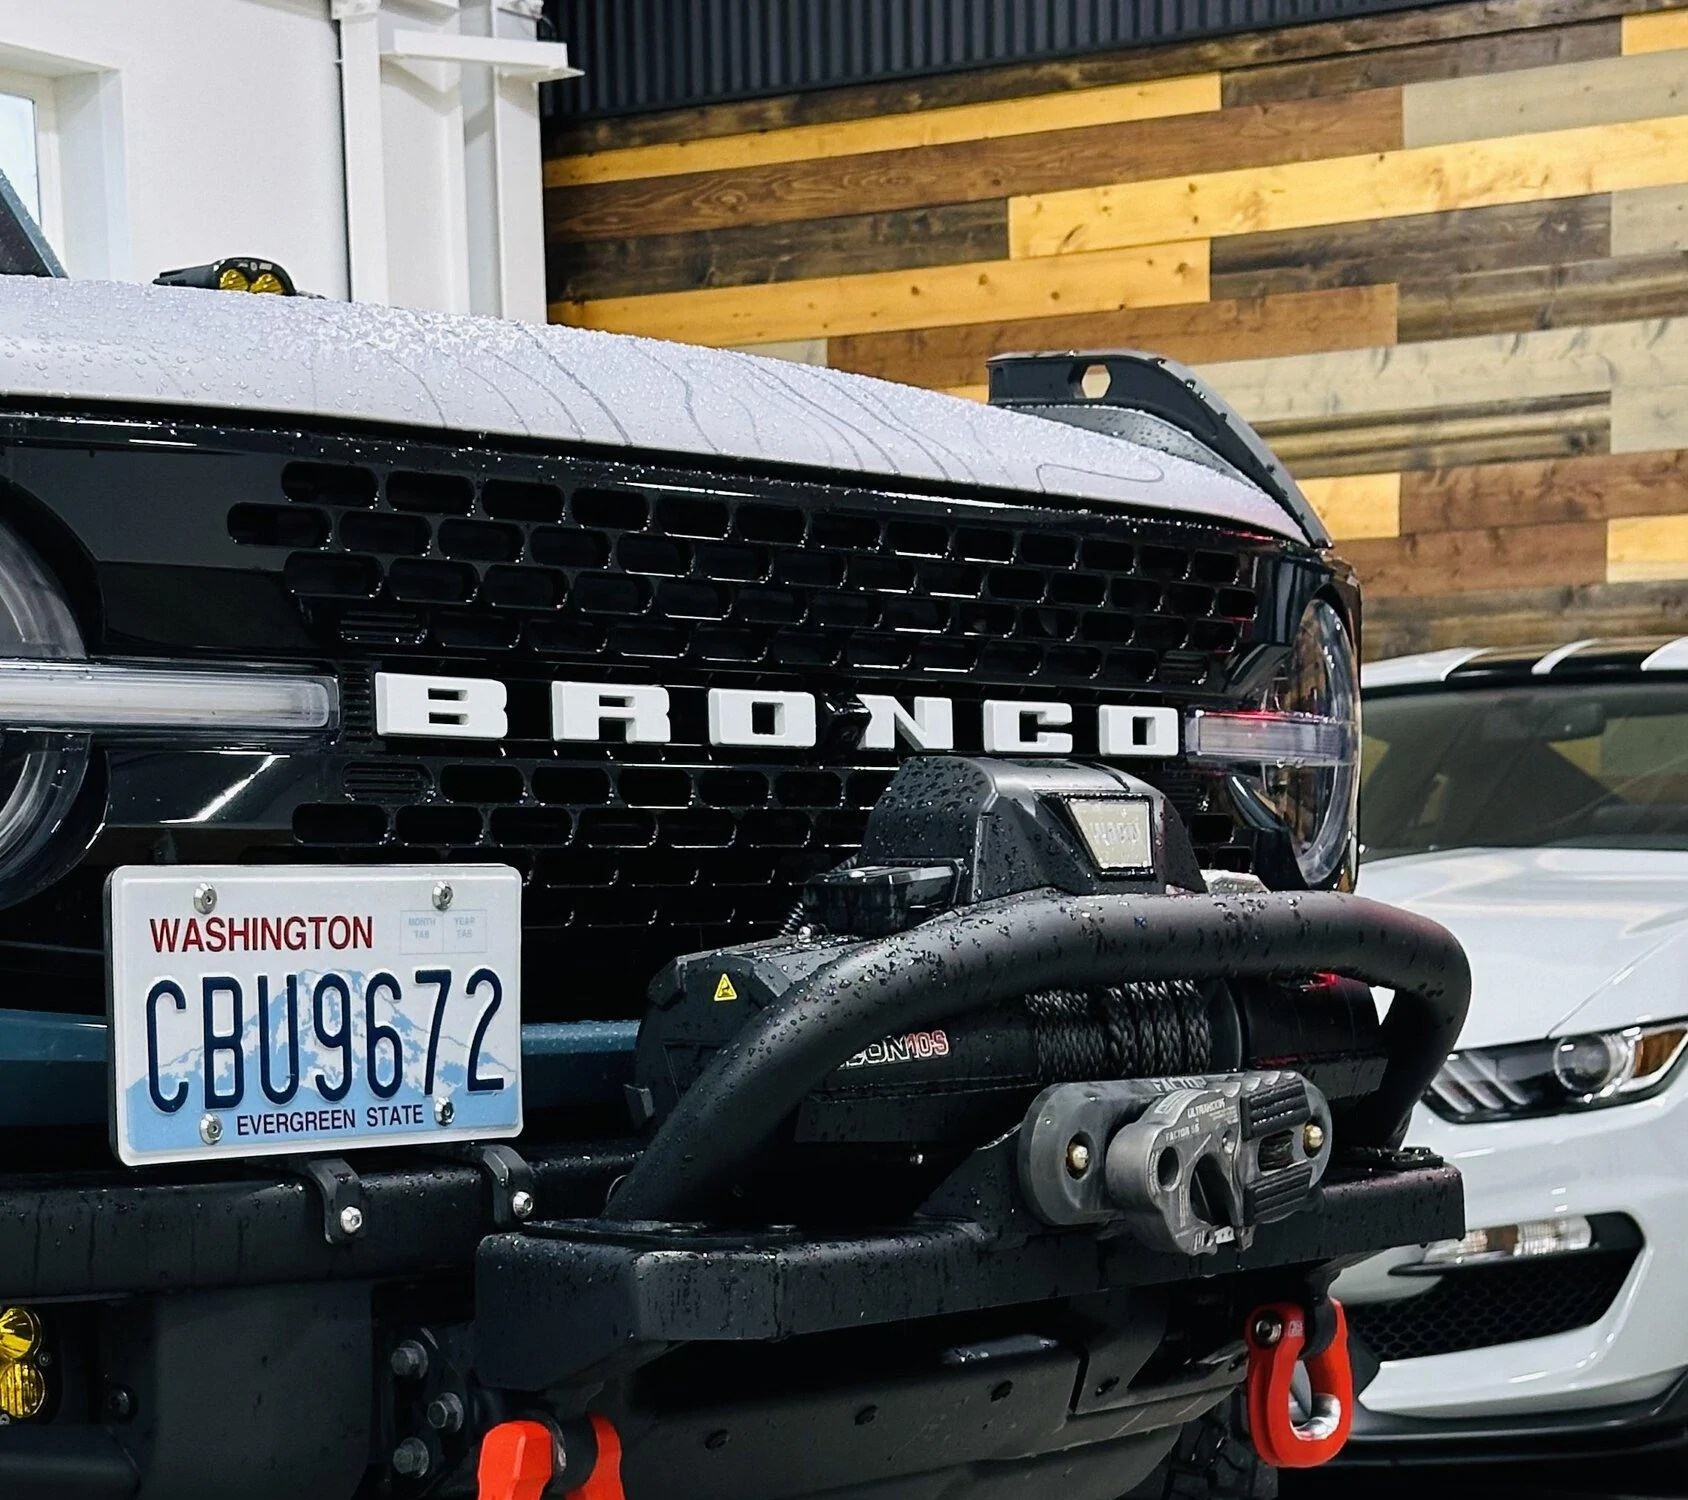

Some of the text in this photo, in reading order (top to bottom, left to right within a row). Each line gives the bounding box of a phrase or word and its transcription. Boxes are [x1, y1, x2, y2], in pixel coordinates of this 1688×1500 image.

[374, 671, 1180, 756] BRONCO
[149, 914, 373, 953] WASHINGTON
[414, 930, 430, 940] TAB
[146, 967, 505, 1114] CBU9672
[236, 1104, 424, 1136] EVERGREEN STATE
